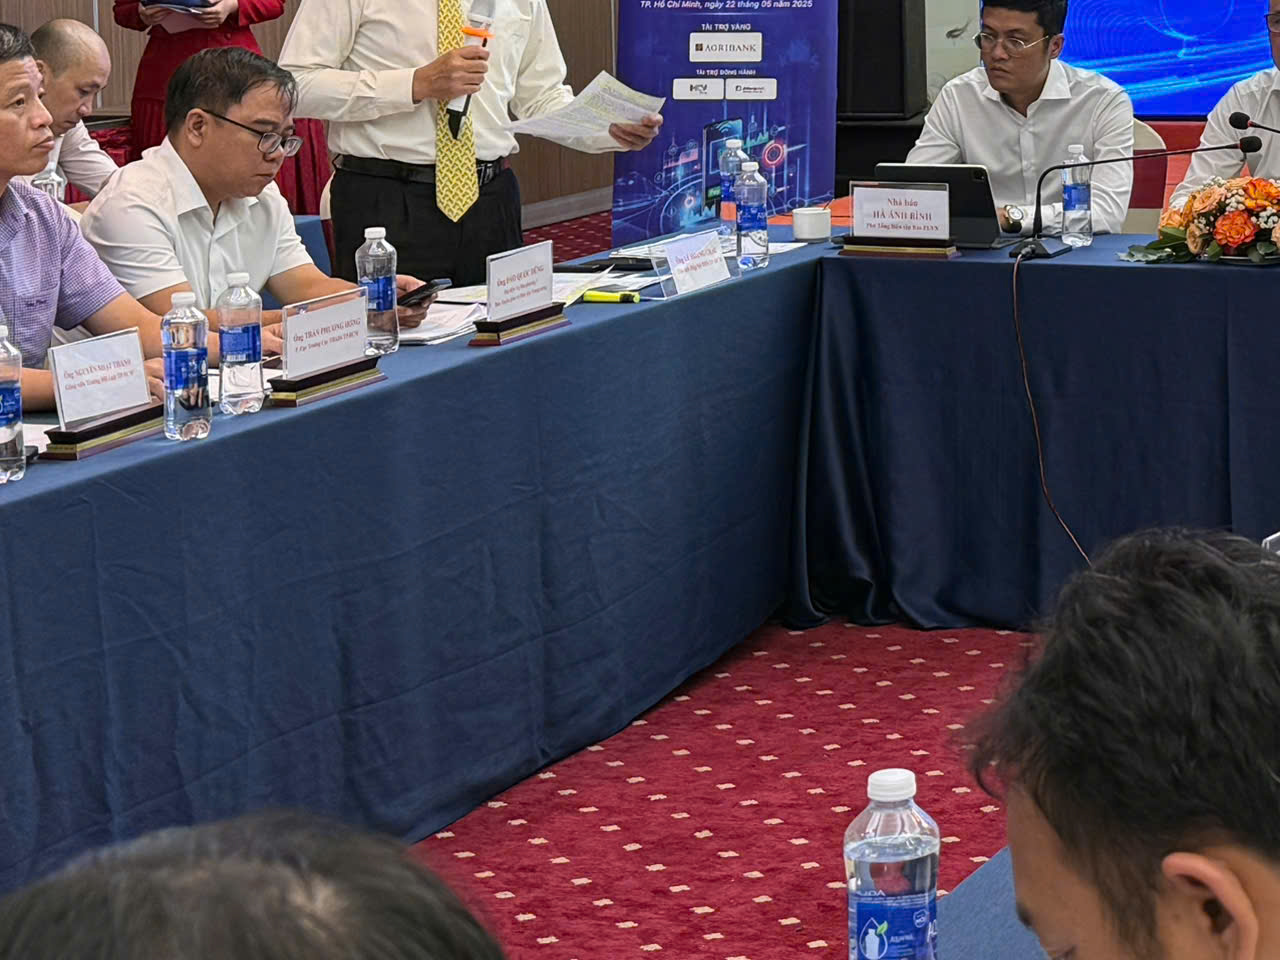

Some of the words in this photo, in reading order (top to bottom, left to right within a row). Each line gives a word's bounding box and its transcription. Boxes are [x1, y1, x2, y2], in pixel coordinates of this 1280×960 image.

[640, 0, 652, 8] TP.
[653, 0, 665, 8] Hồ
[667, 0, 681, 8] Chí
[682, 0, 703, 9] Minh,
[704, 1, 724, 10] ngày
[725, 0, 736, 8] 22
[737, 0, 759, 10] tháng
[761, 0, 772, 8] 05
[773, 0, 791, 7] năm
[792, 0, 813, 8] 2025
[705, 43, 757, 52] AGRIBANK
